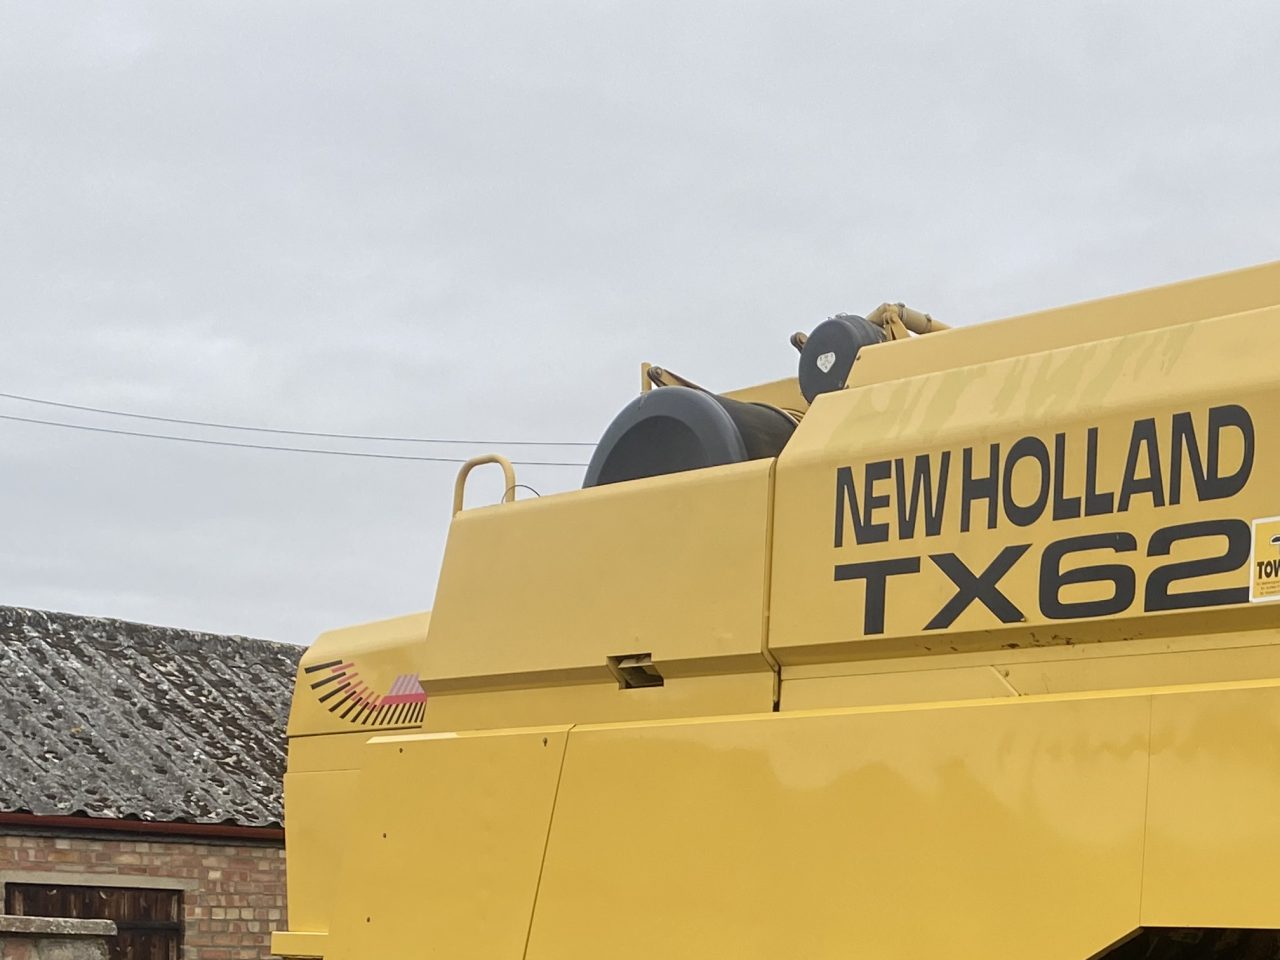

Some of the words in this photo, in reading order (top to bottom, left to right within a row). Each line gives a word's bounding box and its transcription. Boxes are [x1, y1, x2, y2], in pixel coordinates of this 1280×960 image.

[834, 451, 951, 548] NEW
[960, 404, 1255, 533] HOLLAND
[834, 518, 1250, 635] TX62
